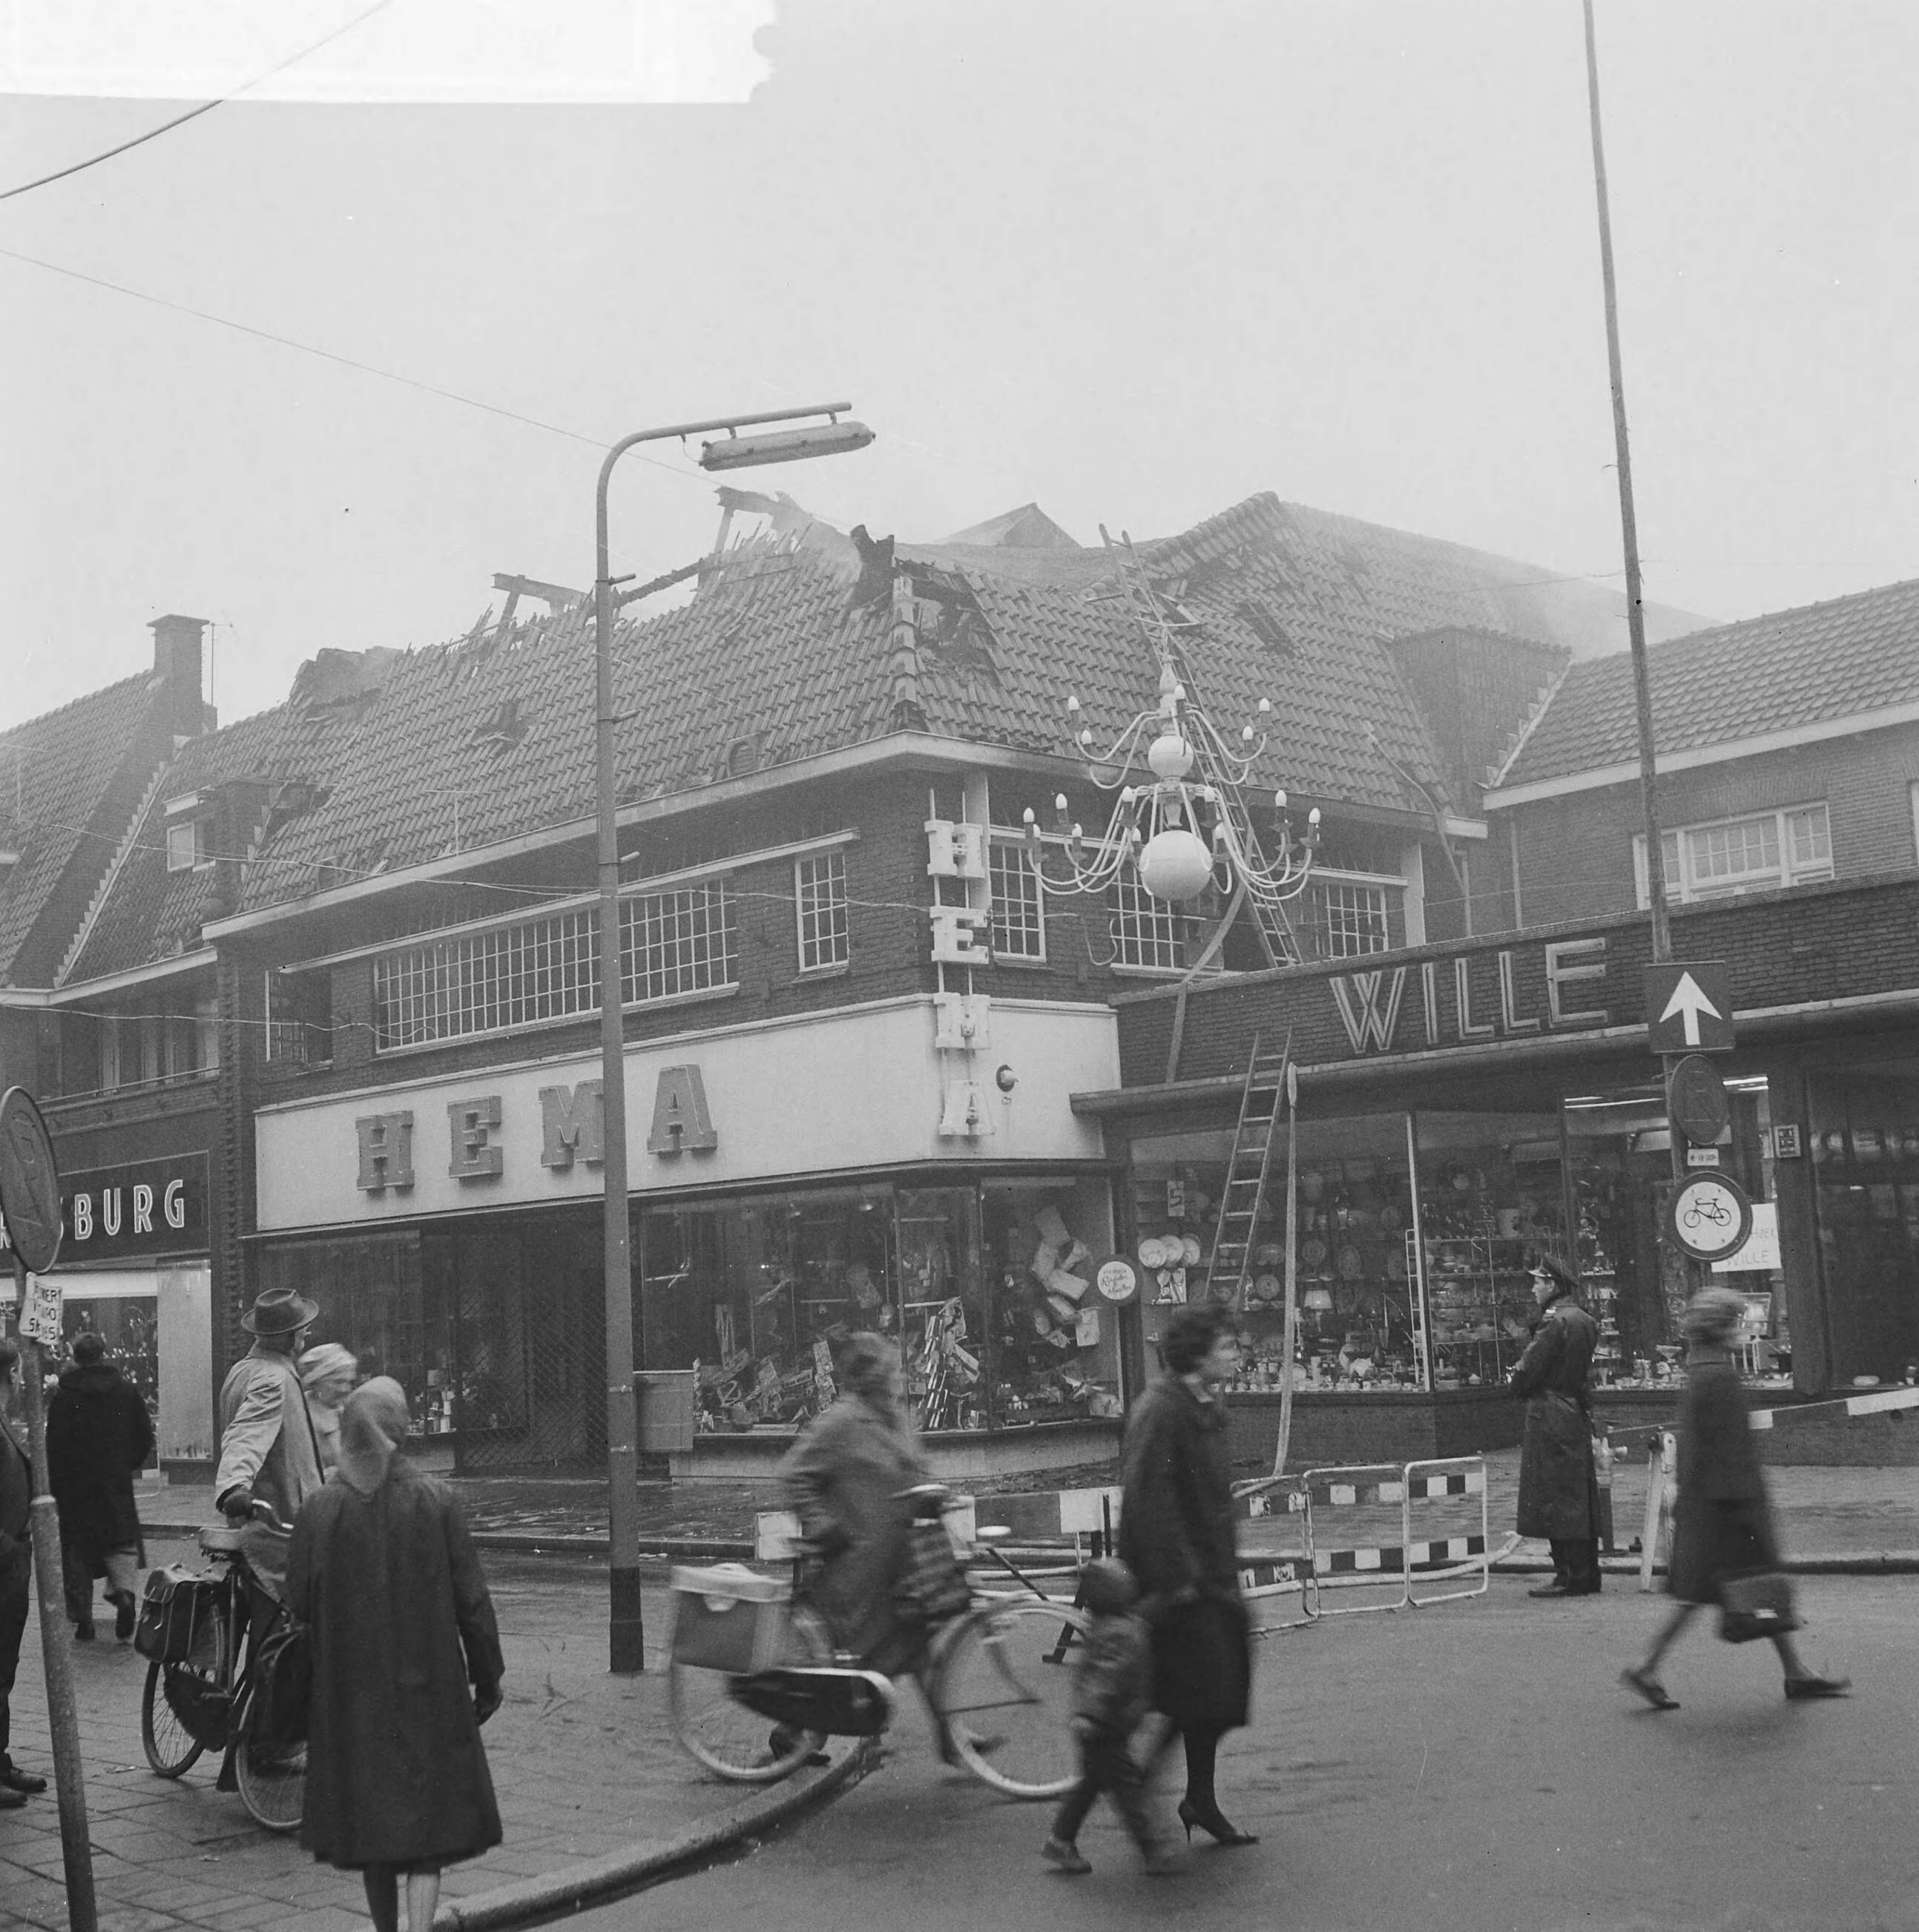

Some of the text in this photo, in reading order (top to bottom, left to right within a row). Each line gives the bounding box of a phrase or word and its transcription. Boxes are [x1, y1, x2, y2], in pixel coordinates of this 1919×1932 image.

[924, 819, 995, 1136] HEMA
[1329, 937, 1608, 1054] WILLE
[355, 1064, 718, 1192] HEMA
